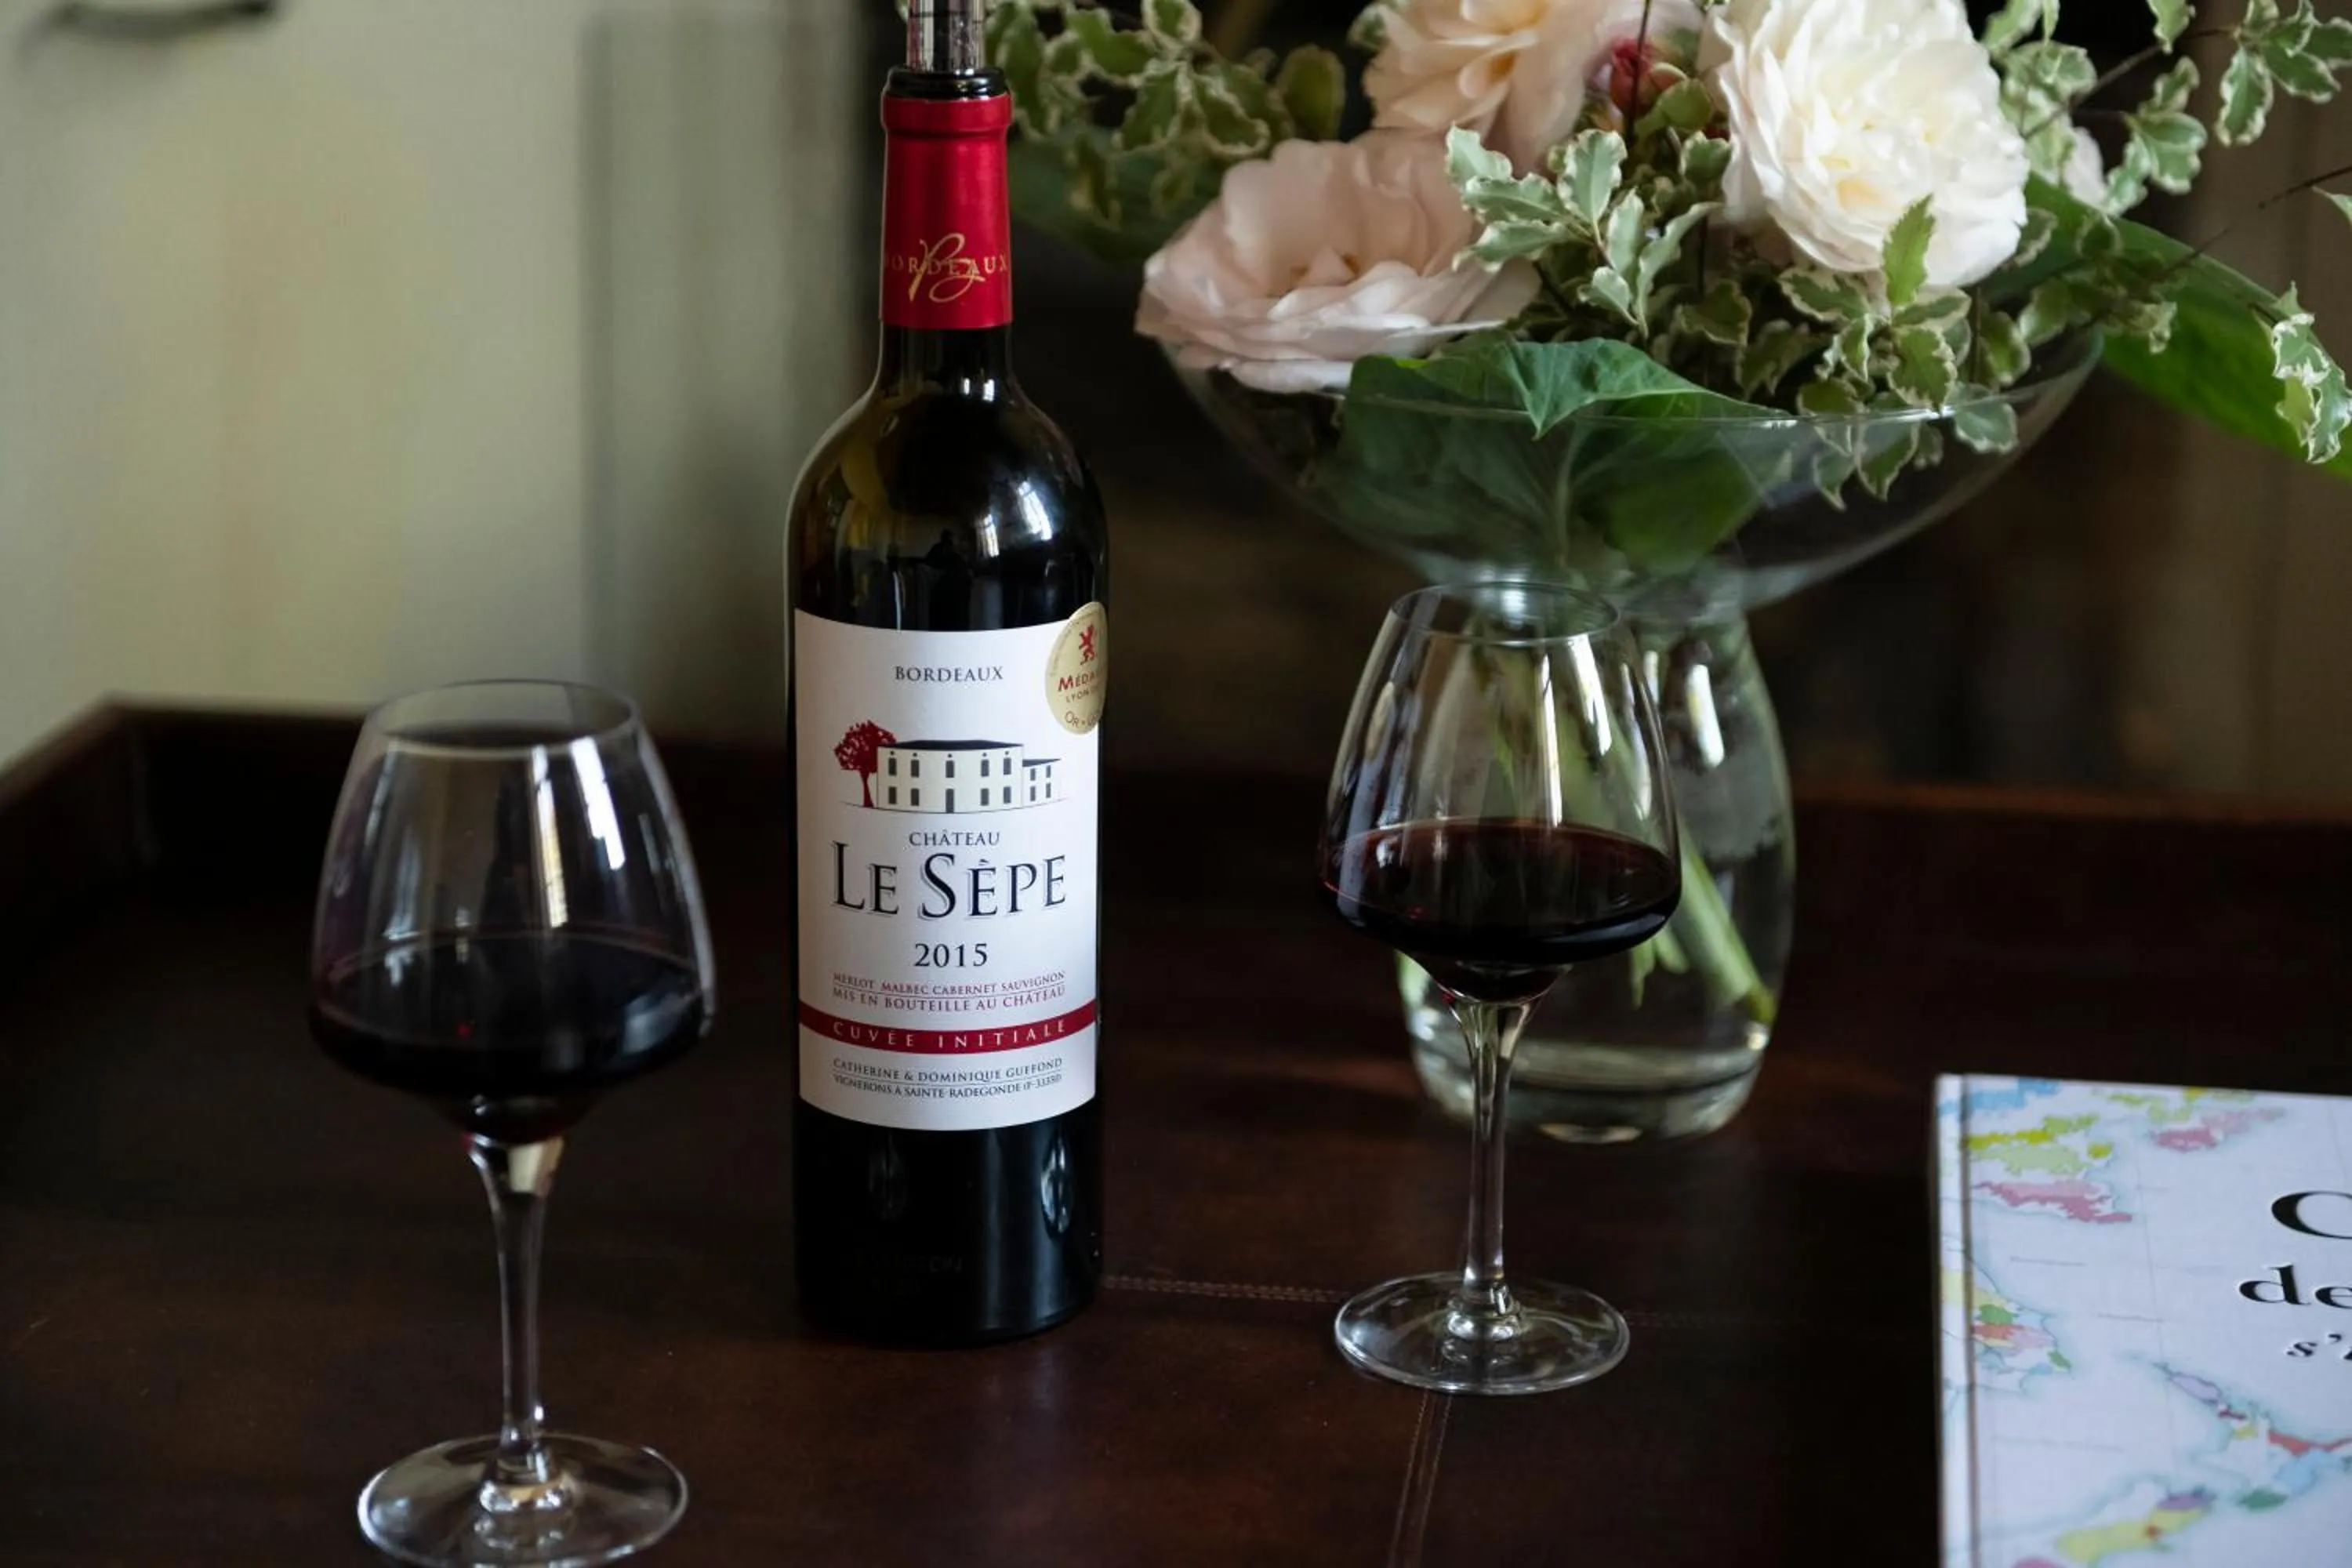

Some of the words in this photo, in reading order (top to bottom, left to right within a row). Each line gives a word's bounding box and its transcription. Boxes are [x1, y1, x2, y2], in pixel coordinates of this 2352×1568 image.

[886, 252, 1007, 276] ORDEAUX
[895, 666, 1004, 683] BORDEAUX
[909, 829, 1000, 846] CHÂTEAU
[831, 839, 900, 916] LE
[914, 943, 988, 967] 2015
[833, 971, 875, 989] MERLOT
[881, 981, 928, 994] MALBEC
[932, 983, 996, 995] CABERNET
[1001, 971, 1065, 991] SAUVIGNON
[833, 985, 856, 1003] MIS
[861, 993, 878, 1006] EN
[884, 997, 970, 1011] BOUTEILLE
[976, 998, 996, 1011] AU
[833, 1022, 914, 1047] CUVÉE
[938, 1019, 1065, 1049] INITIALE
[833, 1058, 900, 1080] CATHERINE
[904, 1071, 913, 1081] &
[918, 1069, 1001, 1083] DOMINIQUE
